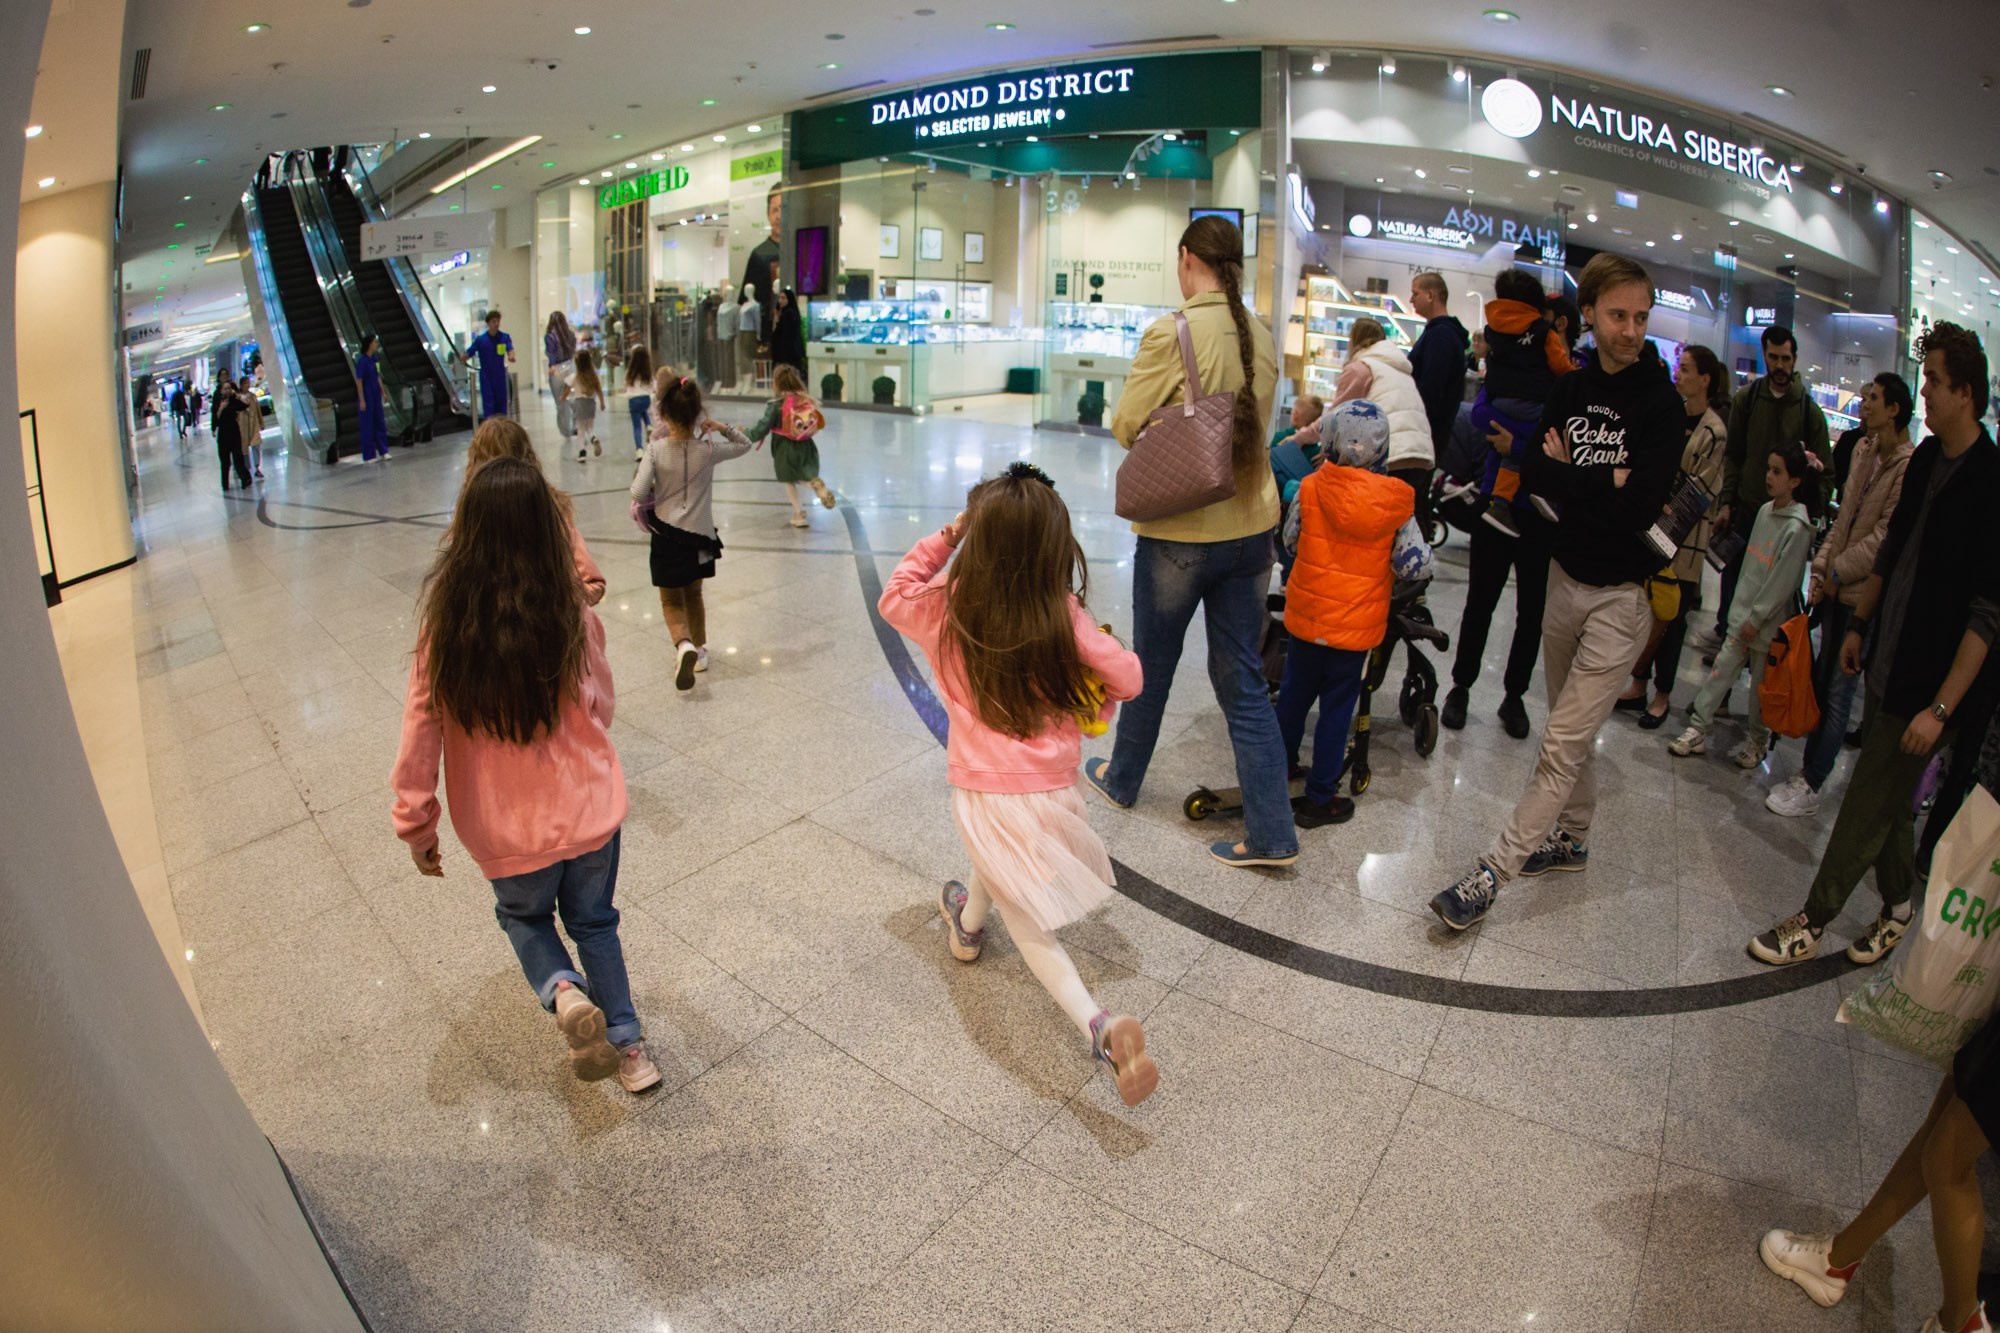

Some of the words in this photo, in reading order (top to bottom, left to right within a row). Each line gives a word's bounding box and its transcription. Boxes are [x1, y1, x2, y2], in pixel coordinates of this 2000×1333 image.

[871, 85, 989, 125] DIAMOND
[998, 68, 1134, 105] DISTRICT
[931, 116, 990, 137] SELECTED
[992, 109, 1051, 131] JEWELRY
[1551, 94, 1678, 154] NATURA
[1683, 129, 1794, 193] SIBERICA
[1574, 134, 1634, 158] COSMETICS
[1636, 151, 1652, 162] OF
[1652, 154, 1678, 170] WILD
[599, 164, 690, 210] GLENFIELD
[1377, 219, 1425, 237] NATURA
[1427, 226, 1475, 245] SIBERICA
[1109, 260, 1163, 272] DISTRICT
